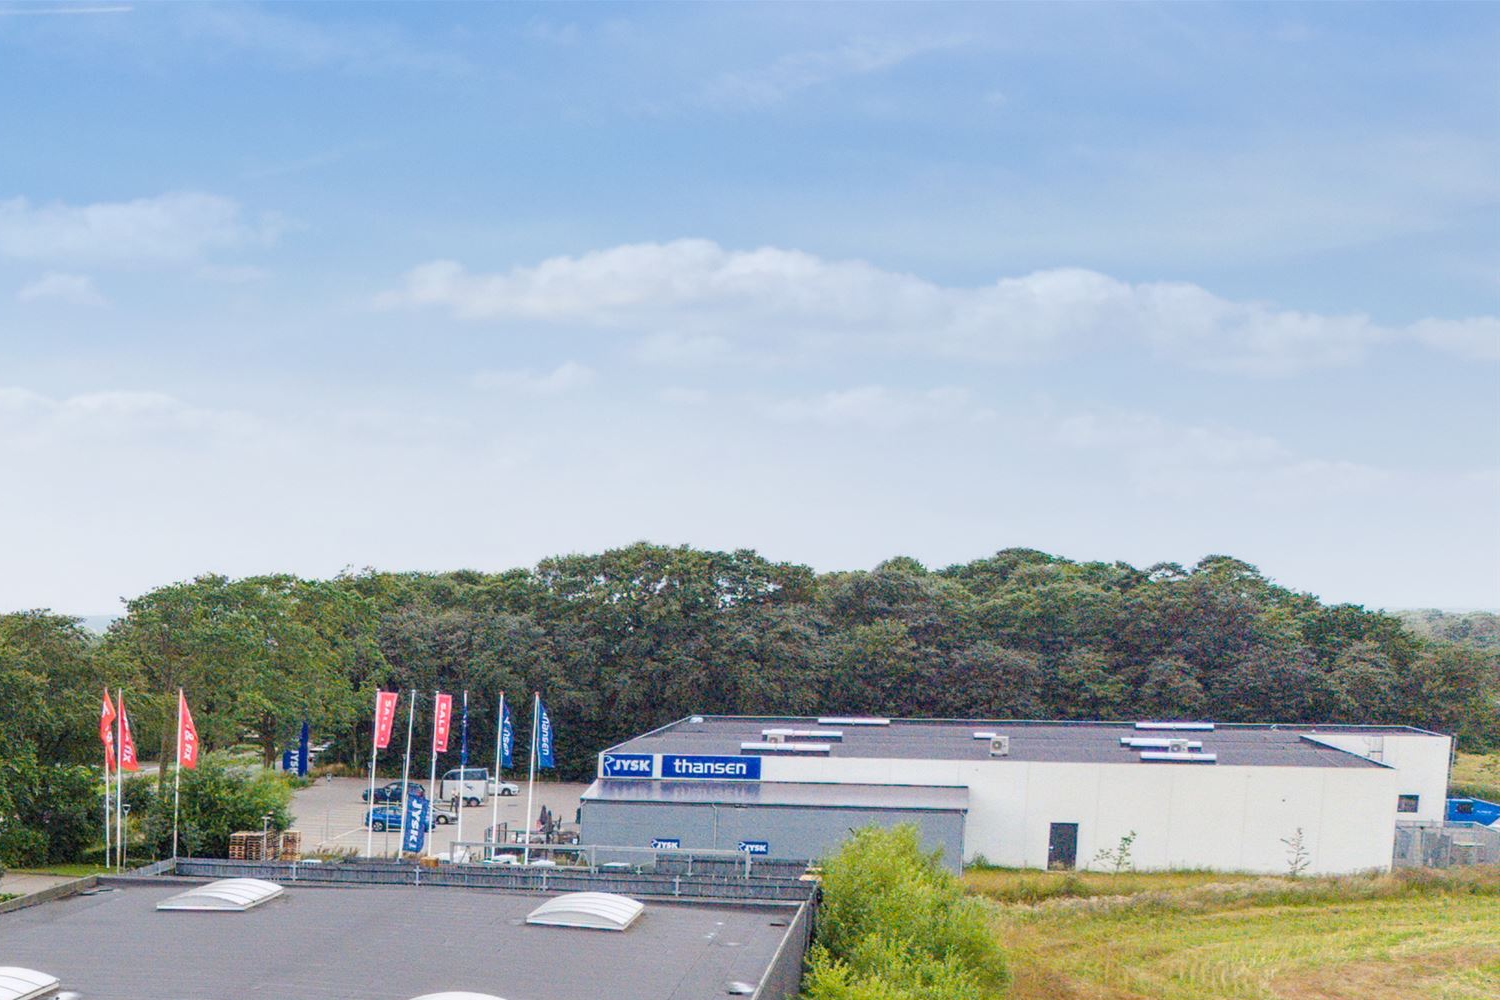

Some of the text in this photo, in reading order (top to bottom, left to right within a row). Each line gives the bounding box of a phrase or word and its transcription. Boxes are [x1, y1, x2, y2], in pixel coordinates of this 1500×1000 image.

[438, 702, 447, 735] SALE
[613, 759, 651, 772] JYSK
[673, 758, 747, 775] thansen
[409, 799, 423, 842] JYSK
